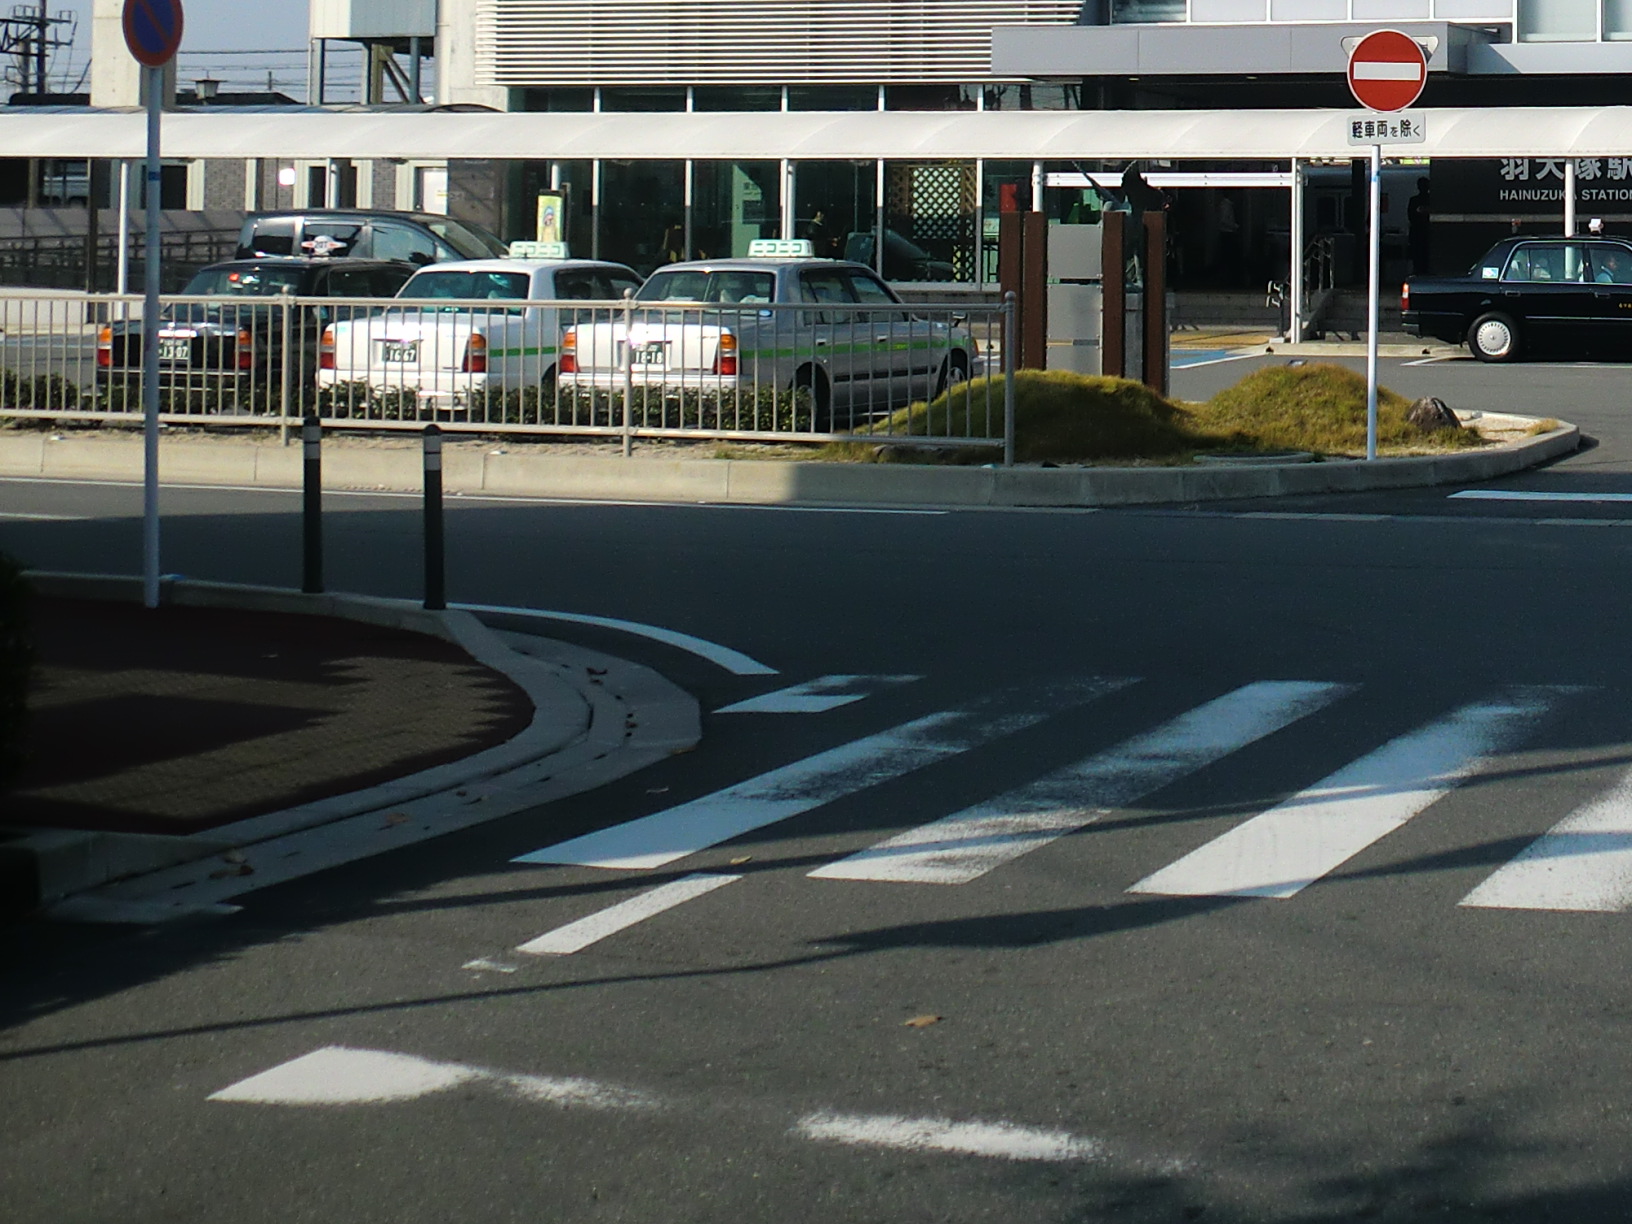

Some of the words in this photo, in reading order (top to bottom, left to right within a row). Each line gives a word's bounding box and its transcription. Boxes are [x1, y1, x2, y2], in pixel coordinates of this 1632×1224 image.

[1351, 118, 1421, 139] 軽車両を除く
[635, 351, 663, 364] 18-18
